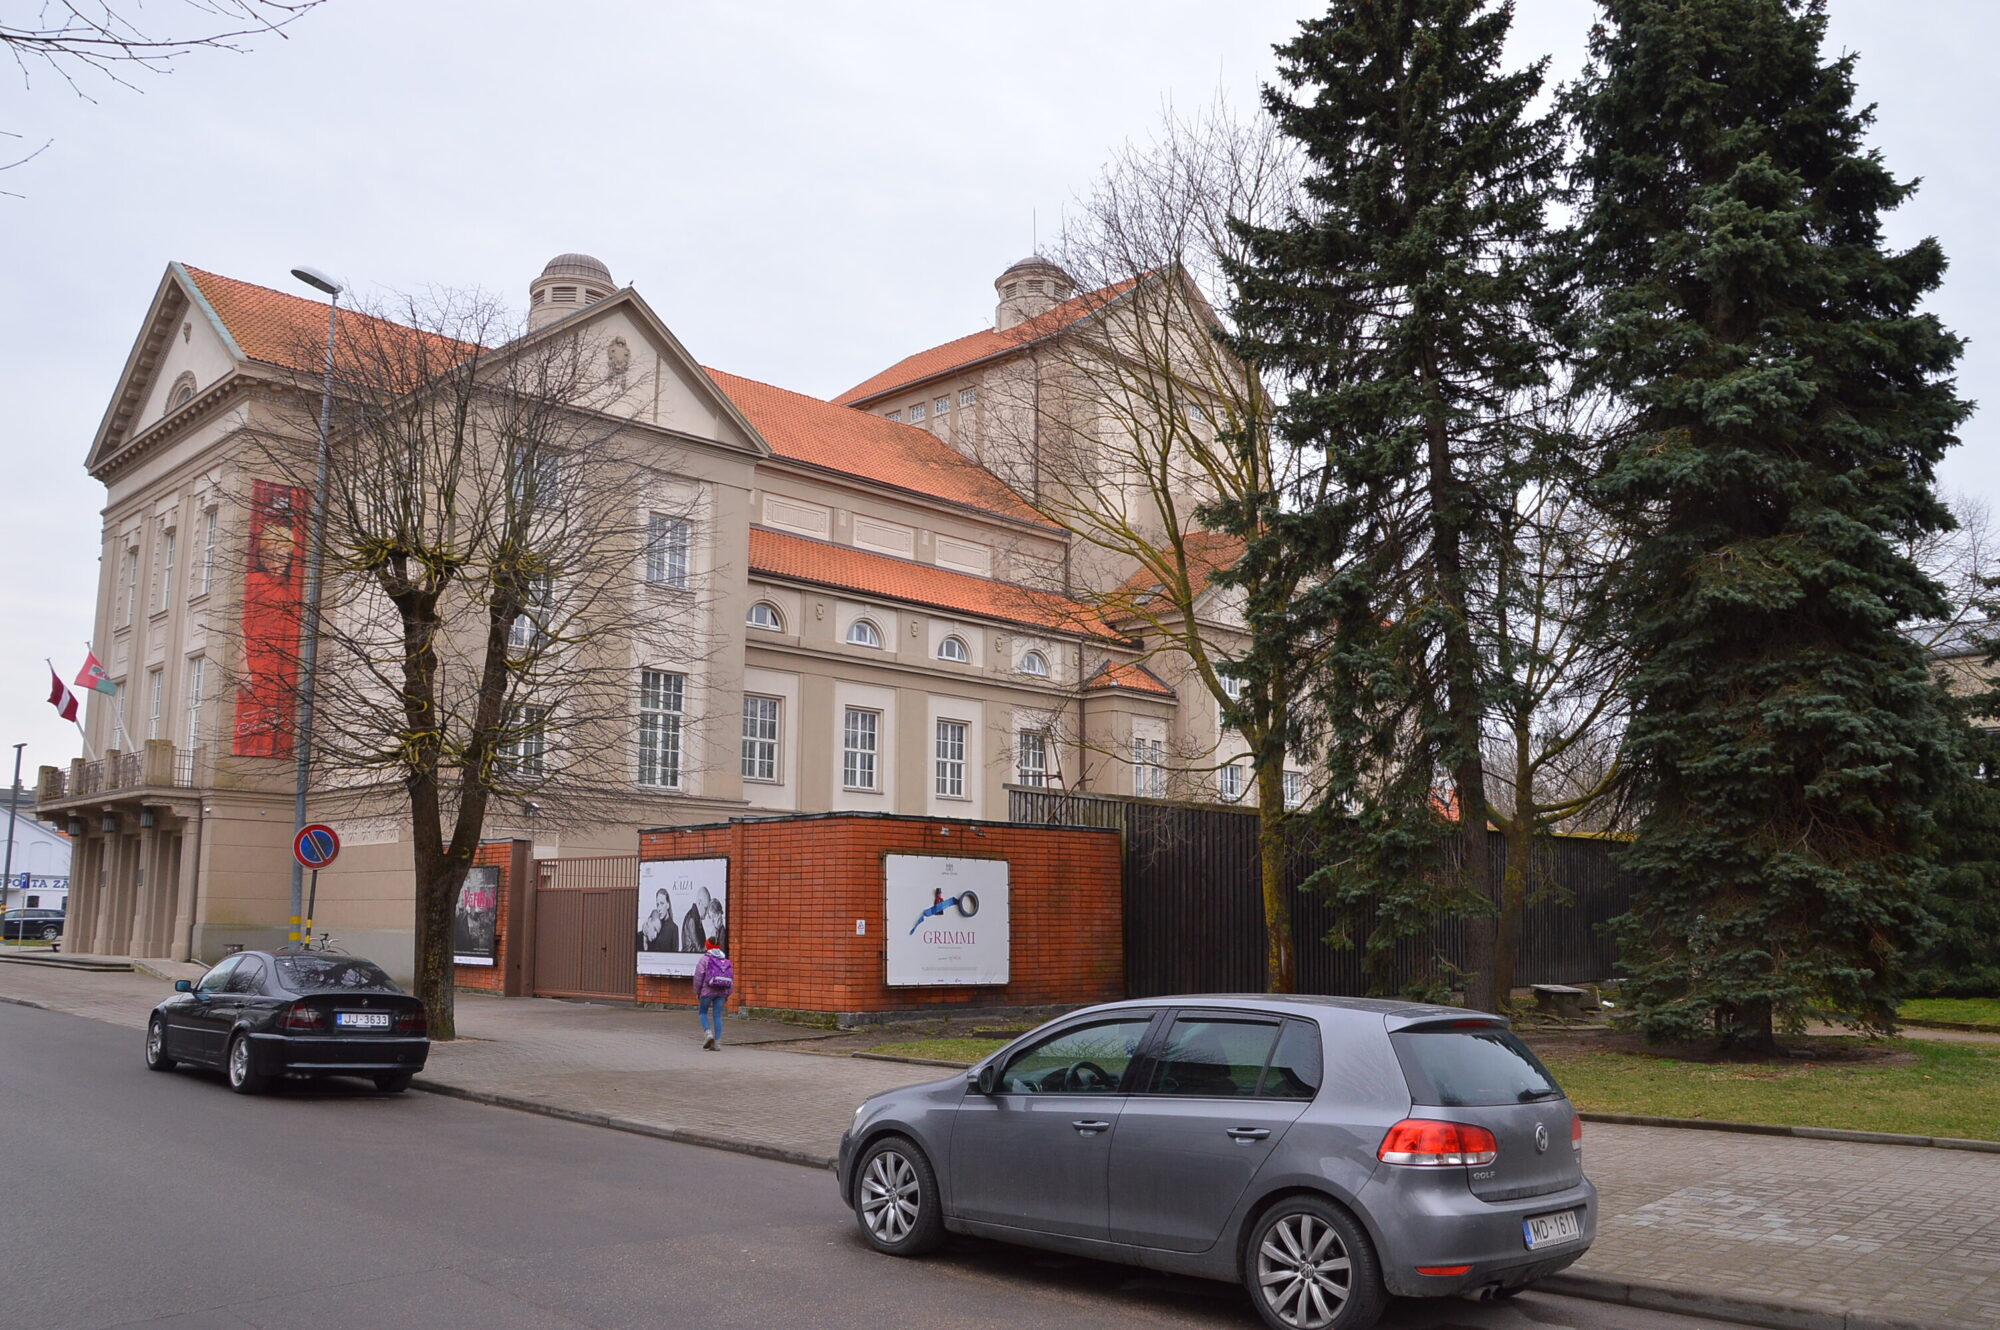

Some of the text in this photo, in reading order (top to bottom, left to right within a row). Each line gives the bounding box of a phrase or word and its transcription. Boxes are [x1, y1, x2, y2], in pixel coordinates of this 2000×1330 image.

[923, 930, 976, 945] GRIMMI
[344, 1014, 387, 1025] JJ-3633
[1473, 1170, 1496, 1180] GOLF
[1530, 1214, 1577, 1241] MD-1611
